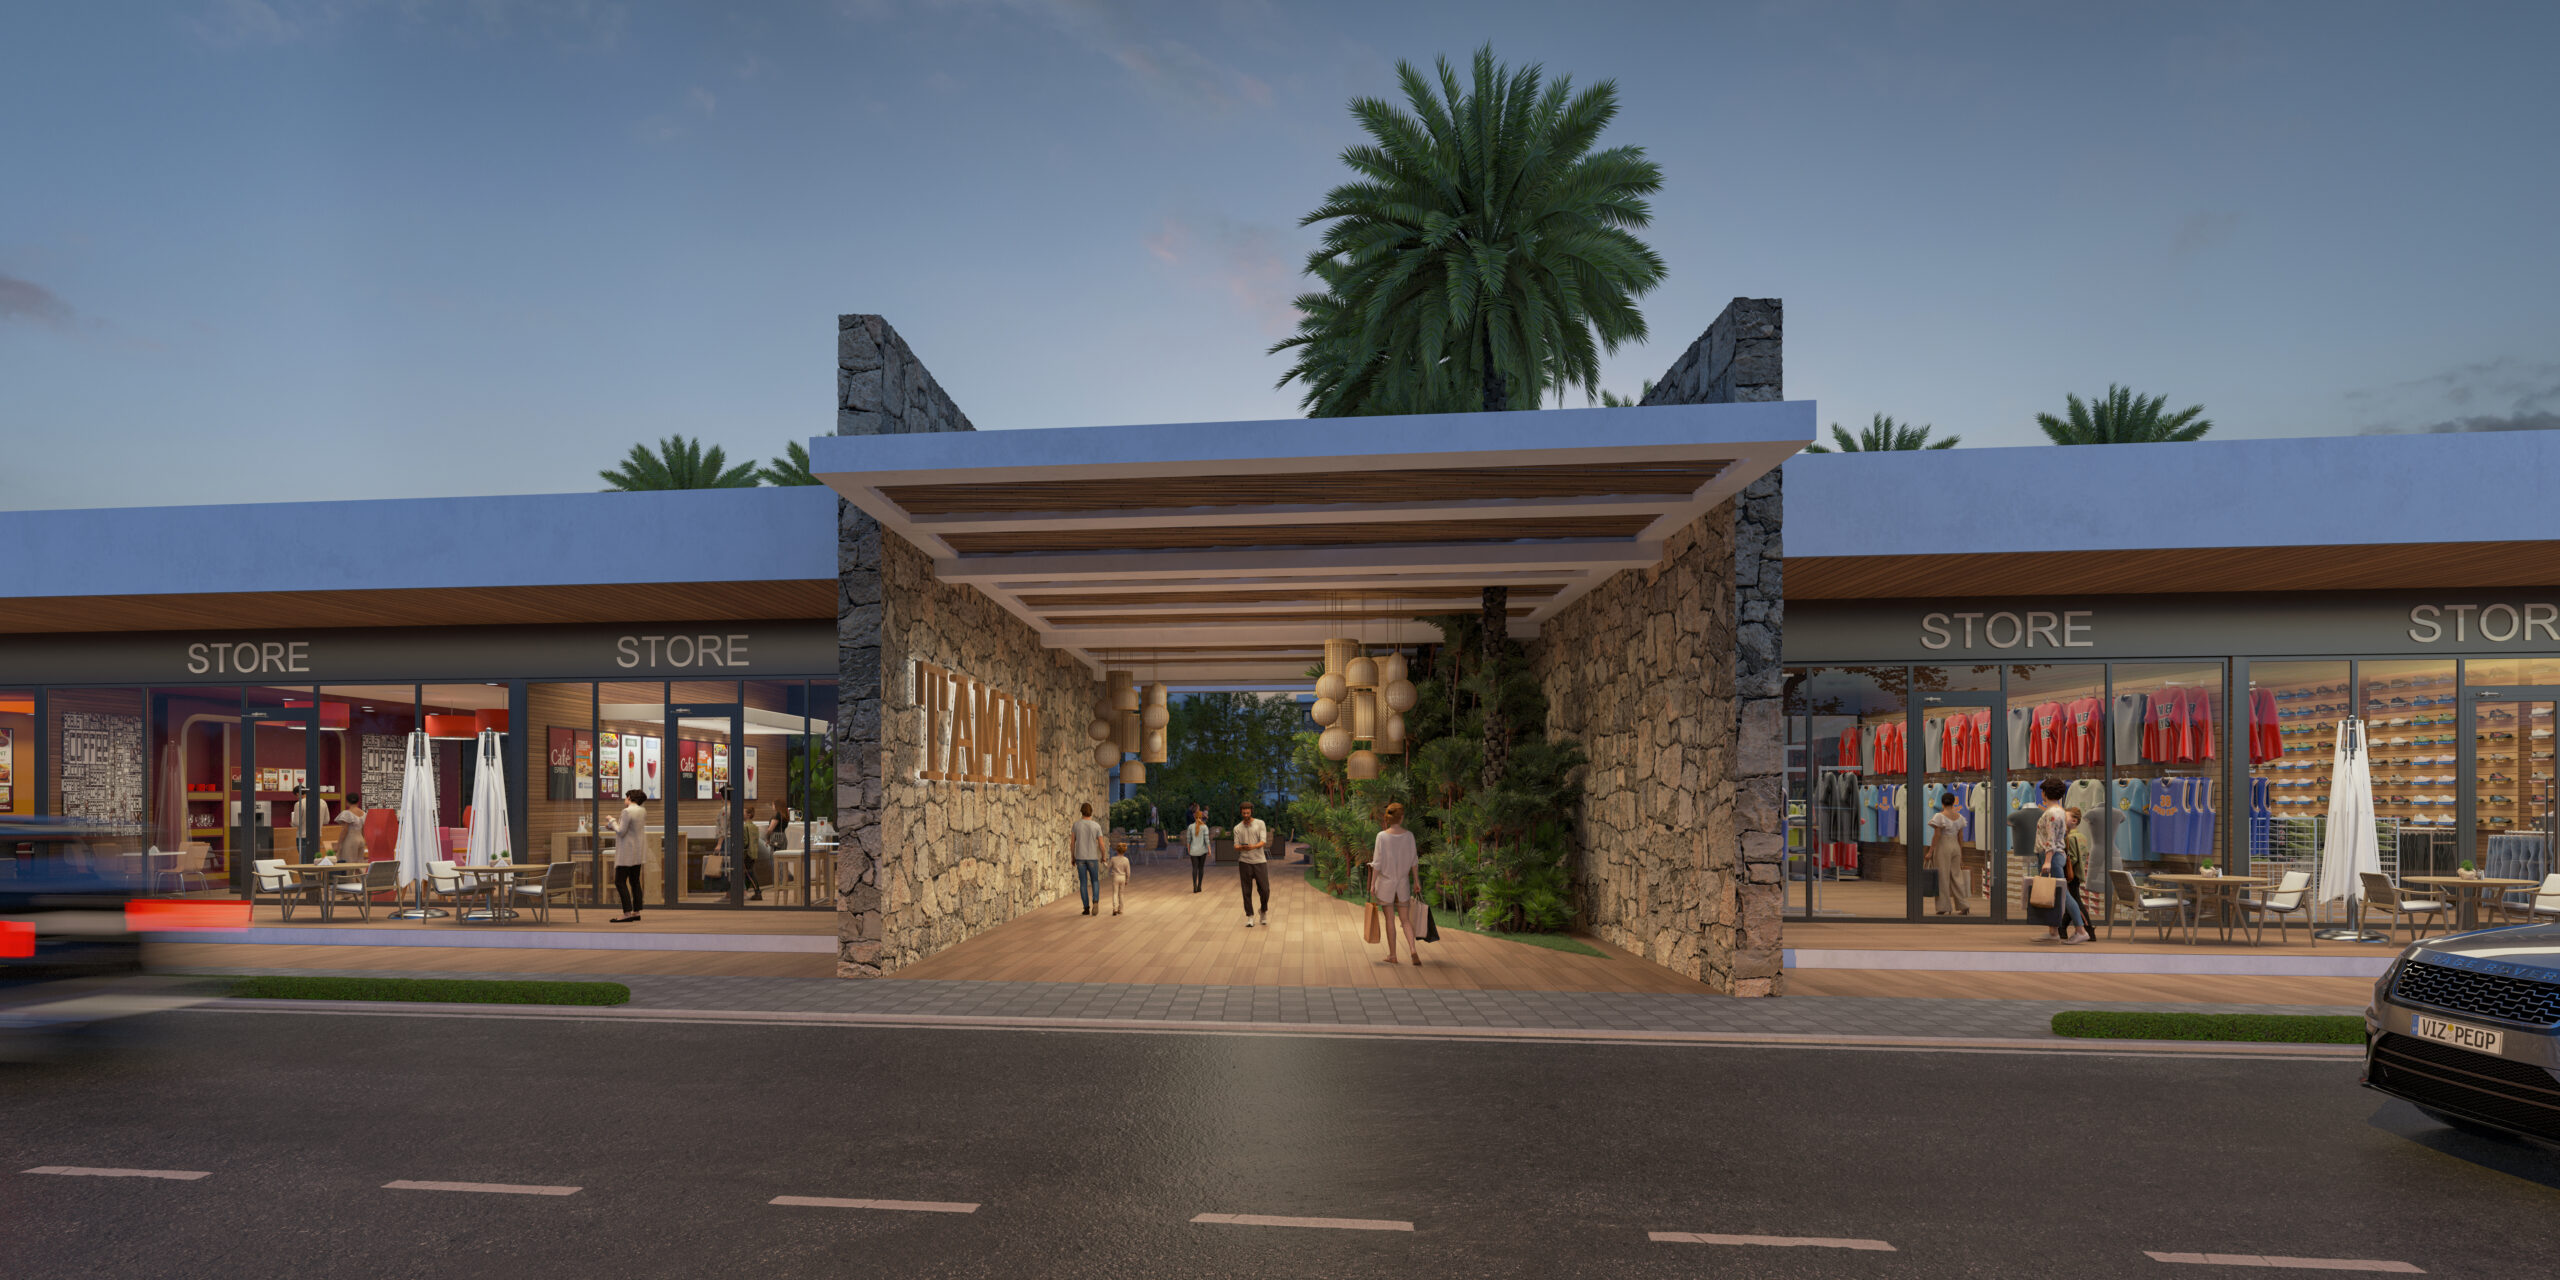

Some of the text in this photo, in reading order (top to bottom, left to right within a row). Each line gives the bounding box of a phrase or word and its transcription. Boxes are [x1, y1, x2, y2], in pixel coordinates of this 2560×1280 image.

[1920, 611, 2094, 649] STORE
[187, 642, 310, 674] STORE
[616, 634, 750, 668] STORE
[914, 660, 1038, 786] TAMAN
[550, 746, 571, 766] Café
[680, 756, 695, 772] Café
[2422, 1018, 2447, 1040] VIZ
